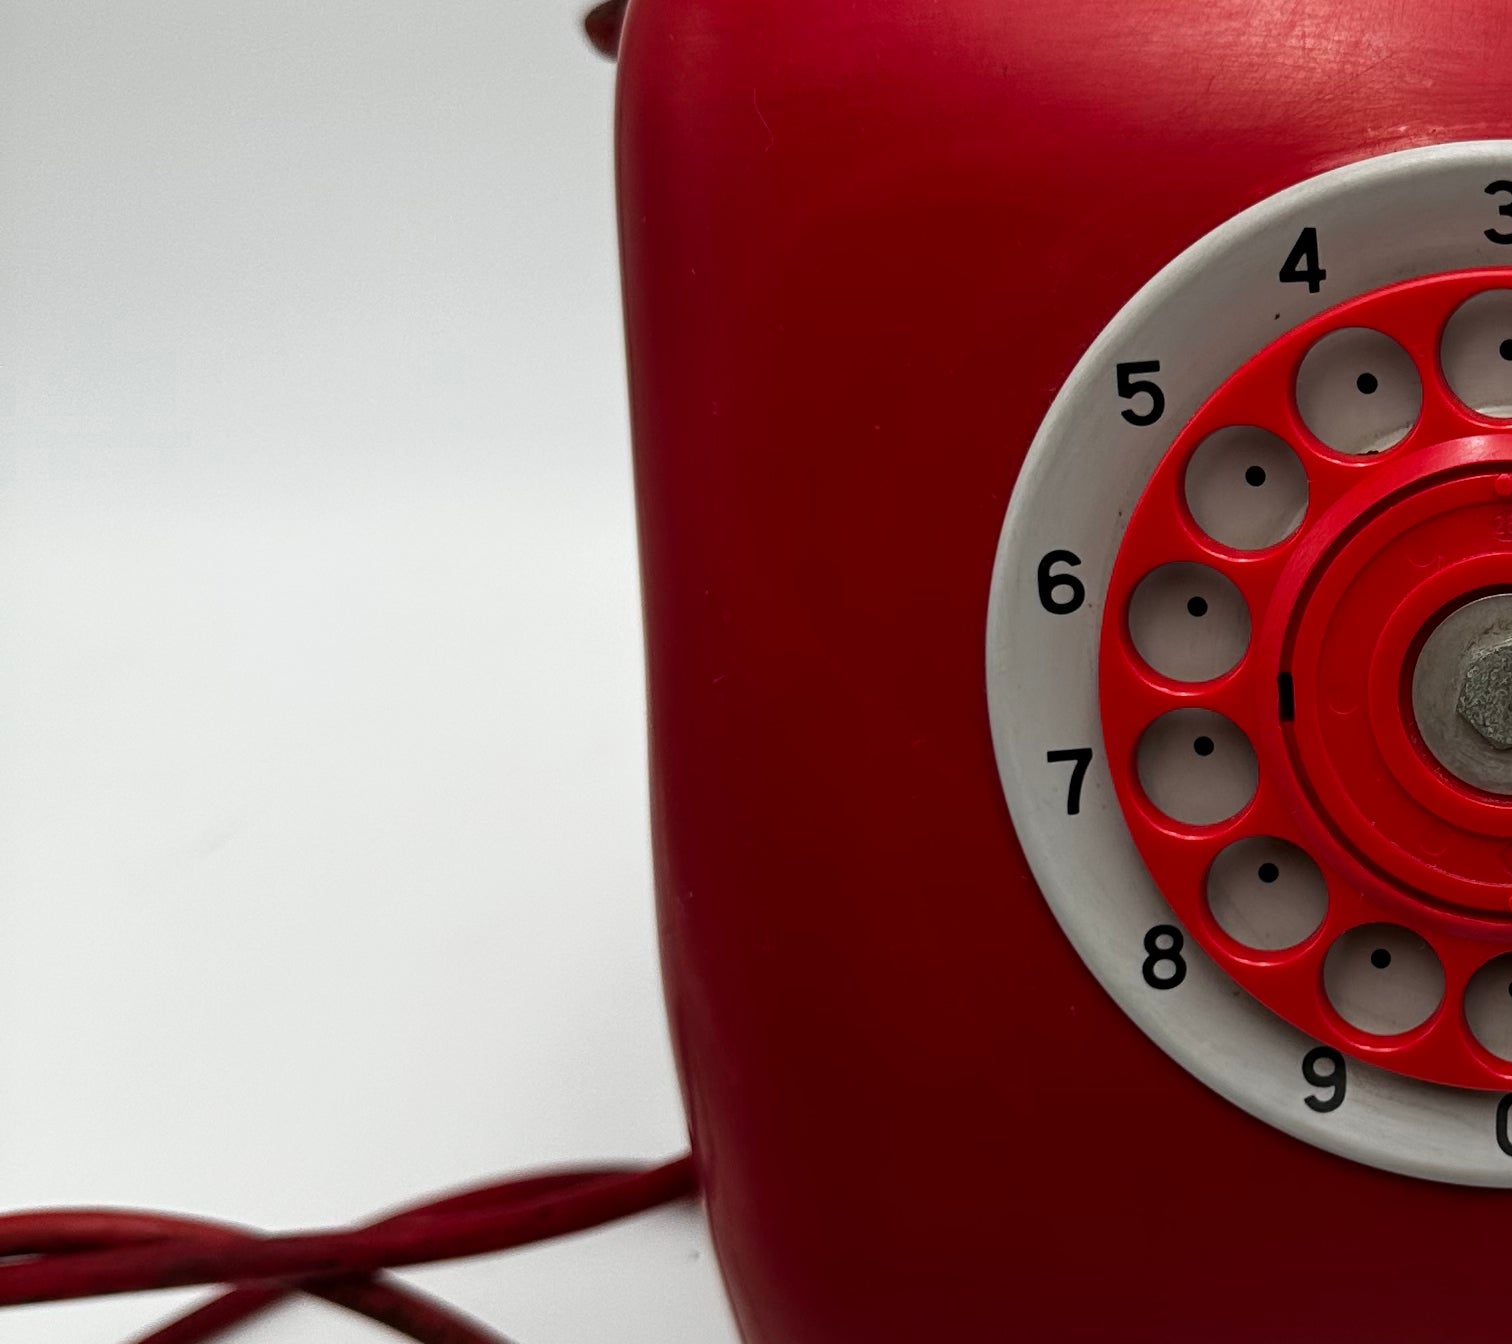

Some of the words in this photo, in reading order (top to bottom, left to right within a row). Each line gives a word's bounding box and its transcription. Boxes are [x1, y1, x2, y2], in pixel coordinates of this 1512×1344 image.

[1278, 226, 1328, 295] 4
[1115, 359, 1166, 428] 5
[1036, 549, 1087, 616] 6
[1046, 746, 1094, 816] 7
[1141, 924, 1189, 991] 8
[1301, 1045, 1347, 1113] 9
